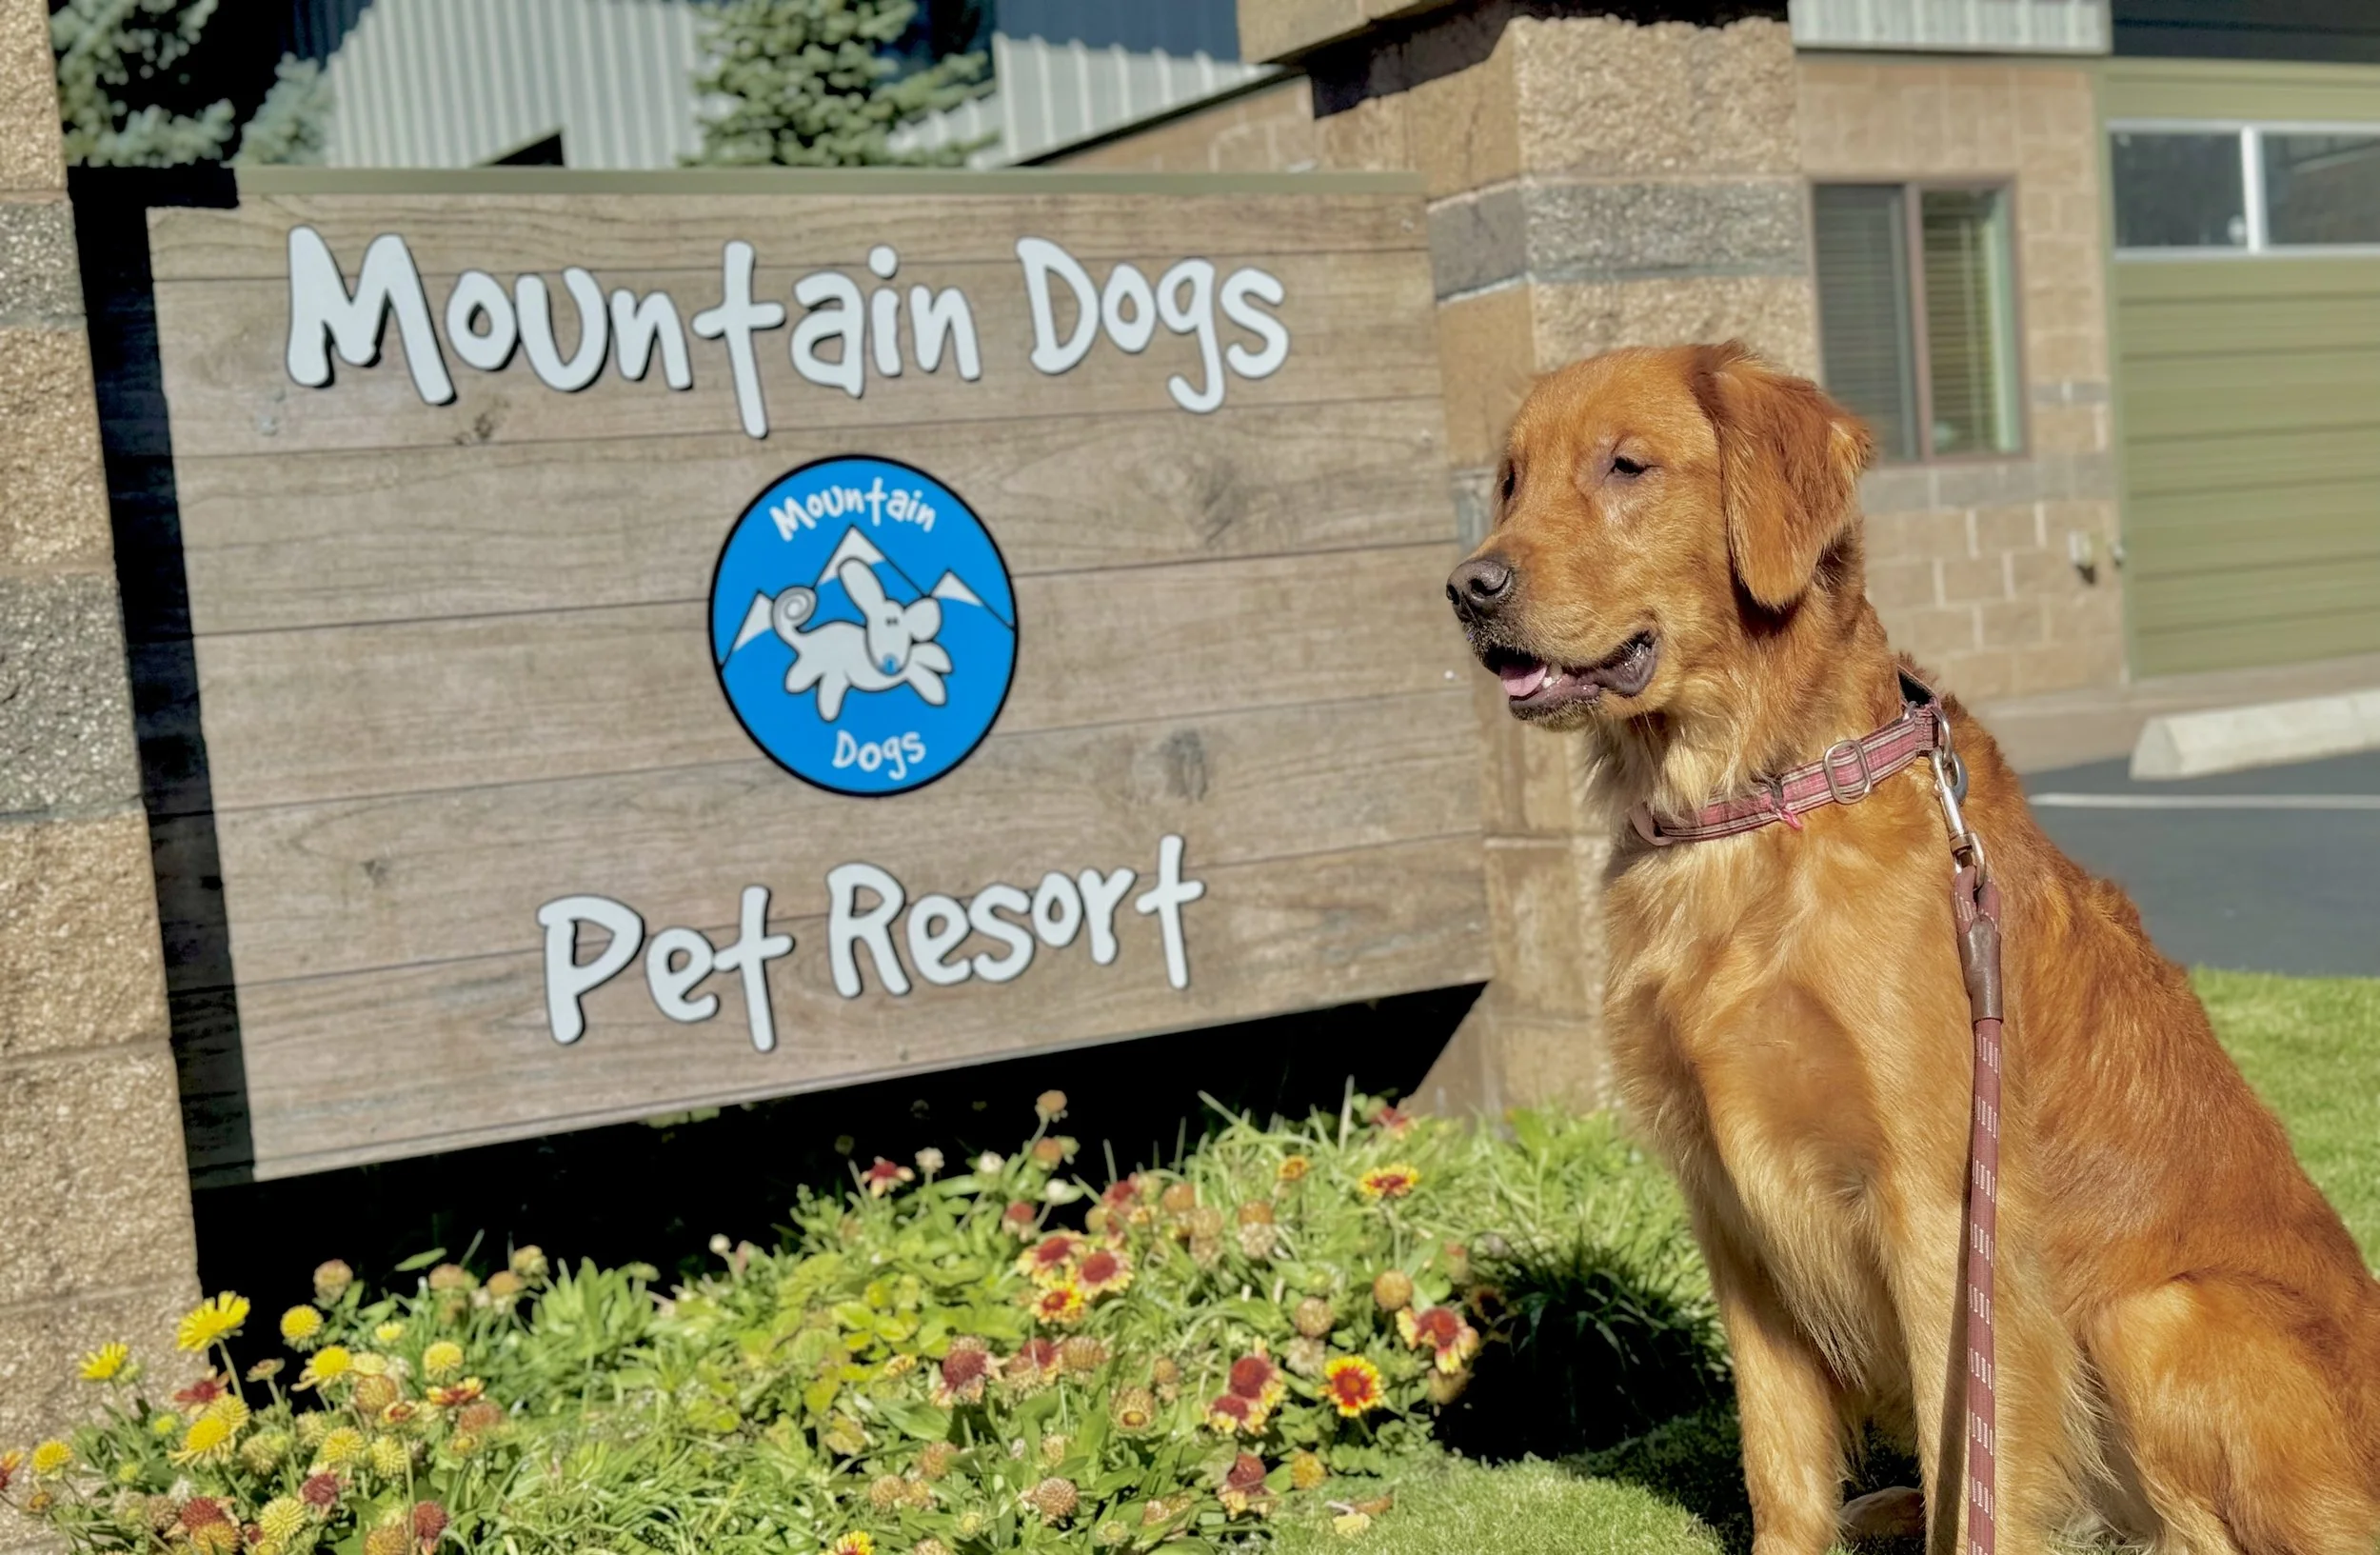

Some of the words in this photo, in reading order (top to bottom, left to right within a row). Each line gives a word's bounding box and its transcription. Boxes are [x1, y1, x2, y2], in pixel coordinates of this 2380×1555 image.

[1015, 236, 1290, 413] Dogs
[832, 729, 926, 781] Dogs
[538, 886, 796, 1053] Pet
[825, 833, 1205, 998] Resort
